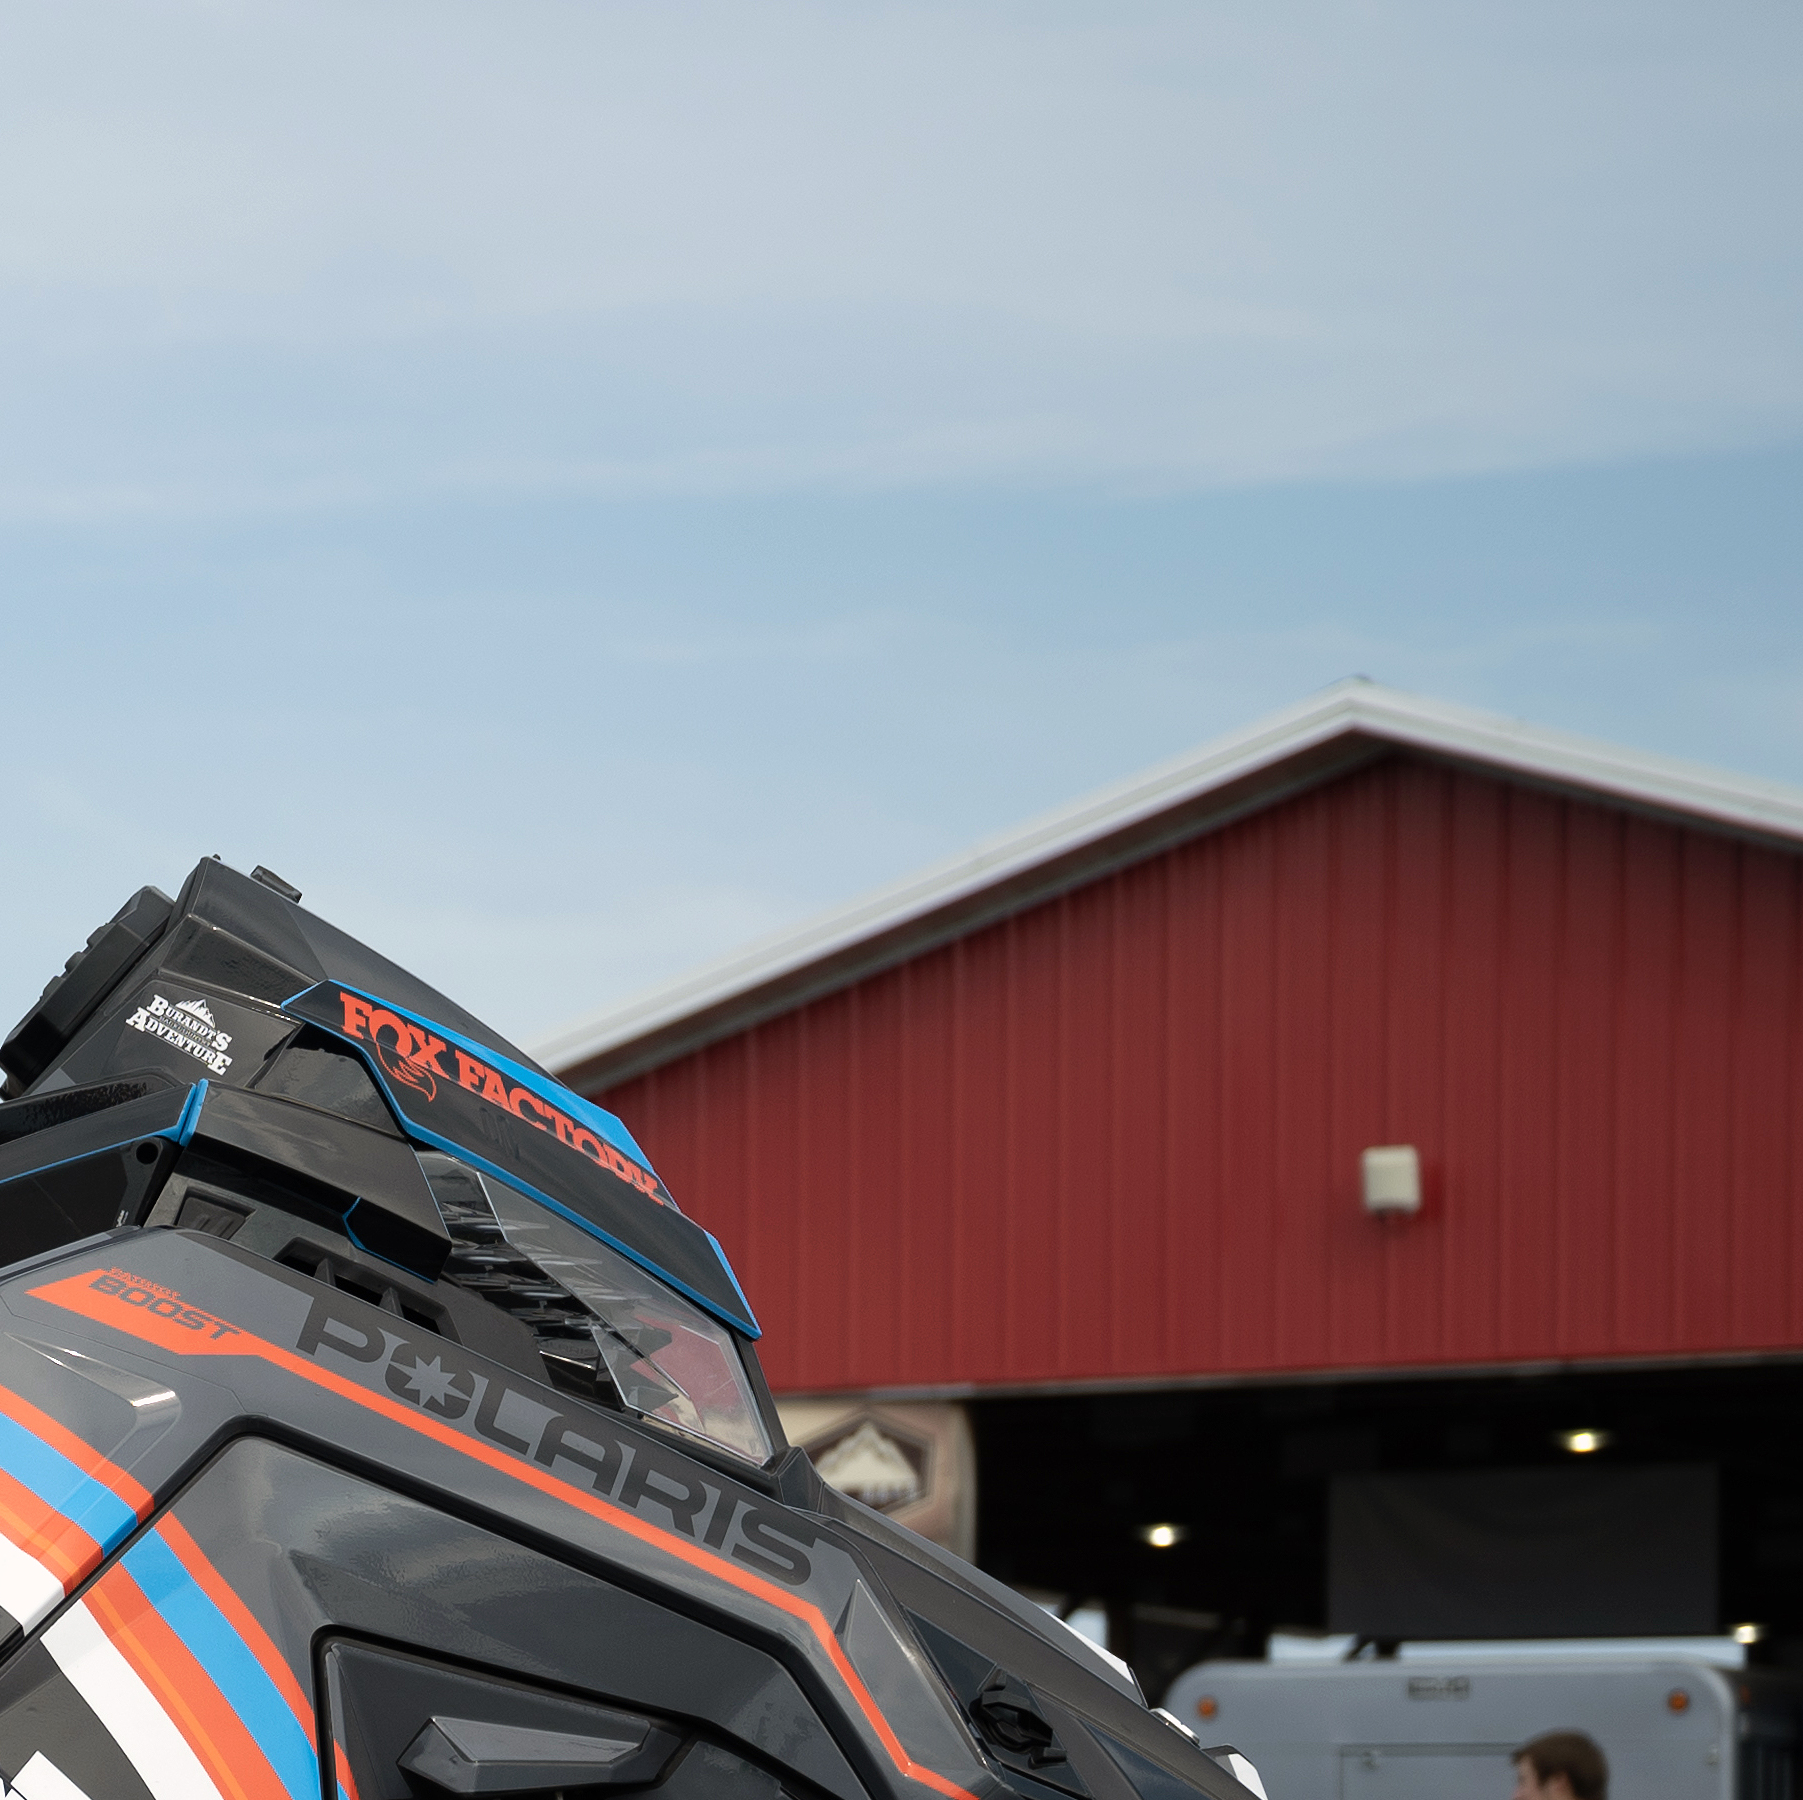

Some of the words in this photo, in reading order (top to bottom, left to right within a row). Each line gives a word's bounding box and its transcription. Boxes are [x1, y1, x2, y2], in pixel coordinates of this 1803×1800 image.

[125, 1006, 233, 1076] ADVENTURE
[146, 994, 232, 1051] BURANDT'S
[340, 991, 450, 1101] FOX
[454, 1049, 664, 1206] FACTORY
[88, 1275, 242, 1341] BOOST
[296, 1298, 820, 1587] POLARIS
